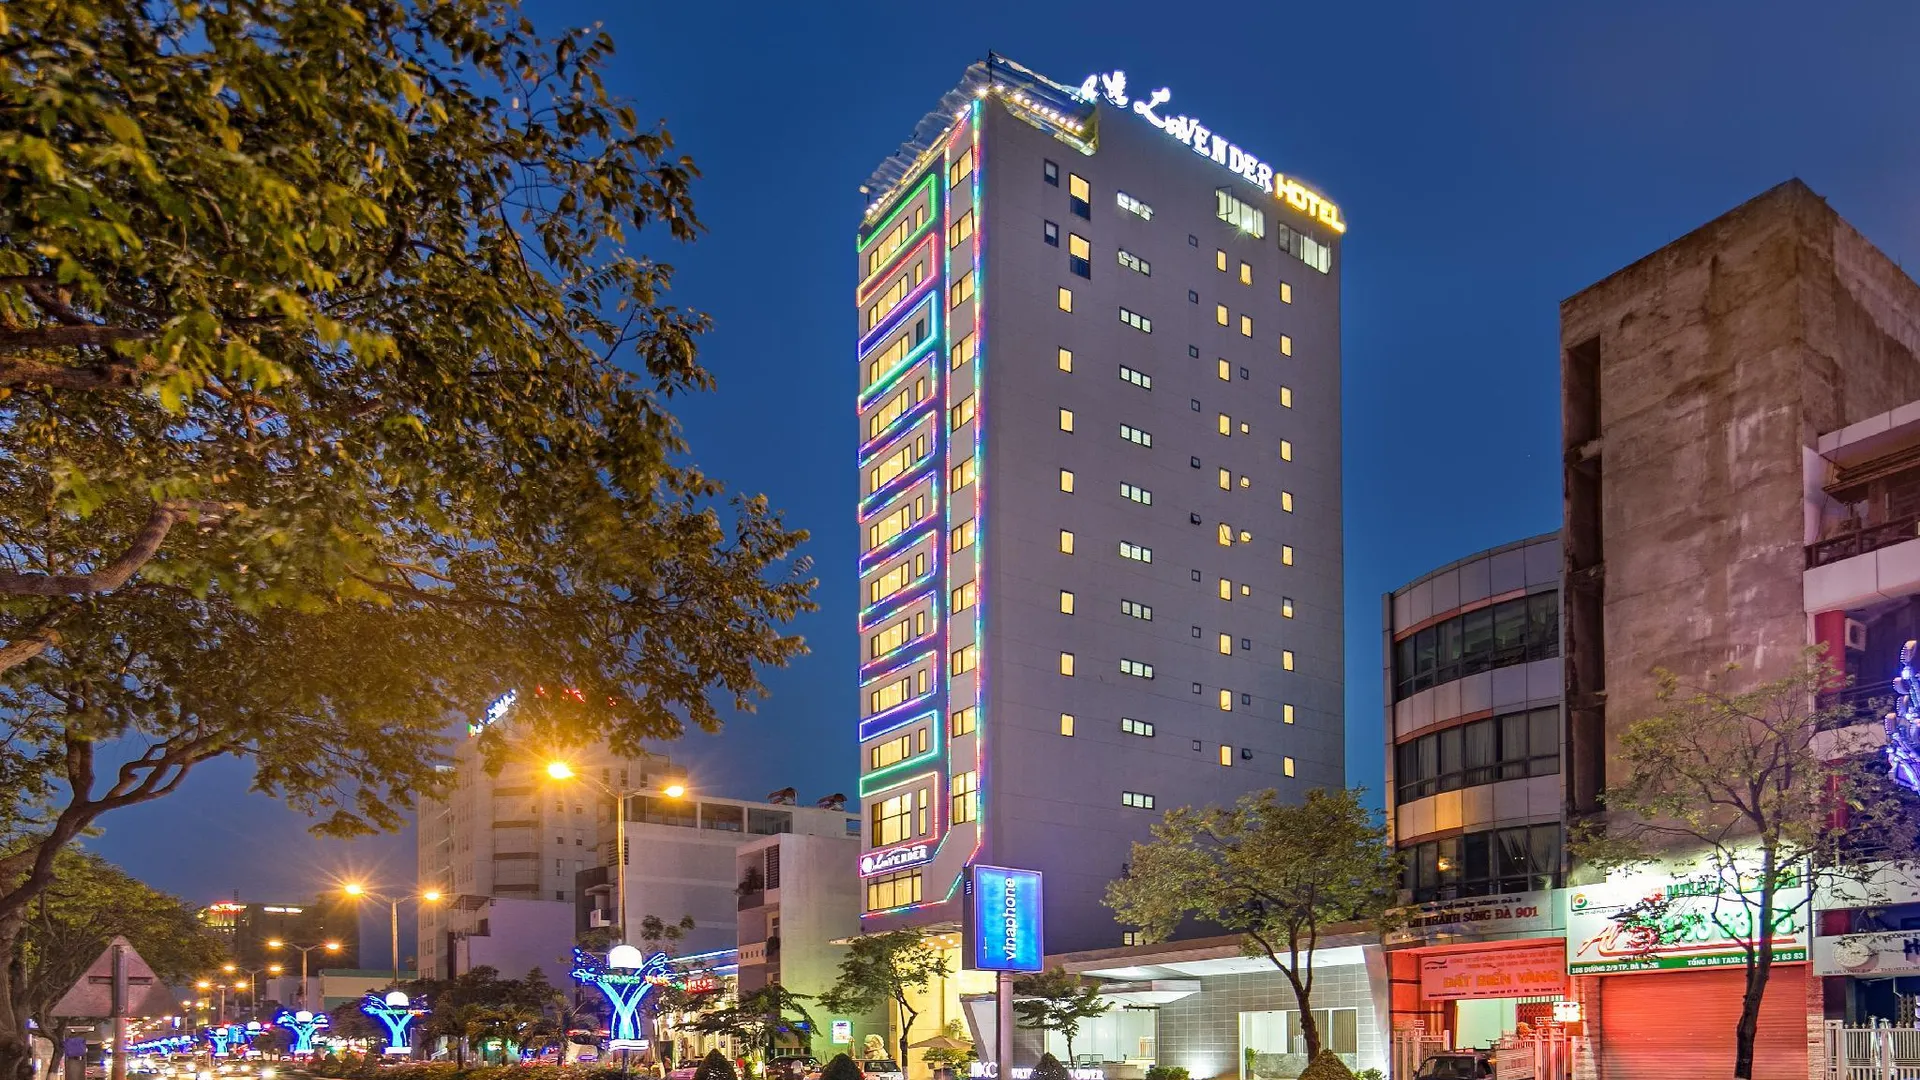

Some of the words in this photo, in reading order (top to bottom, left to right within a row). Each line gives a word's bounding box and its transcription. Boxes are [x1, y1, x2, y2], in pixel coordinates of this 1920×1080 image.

[1275, 173, 1346, 233] HOTEL
[1002, 877, 1019, 961] vinaphone
[1495, 905, 1512, 919] ĐÀ
[1515, 905, 1538, 918] 901
[1619, 963, 1629, 971] TP.
[1516, 968, 1559, 984] VÀNG
